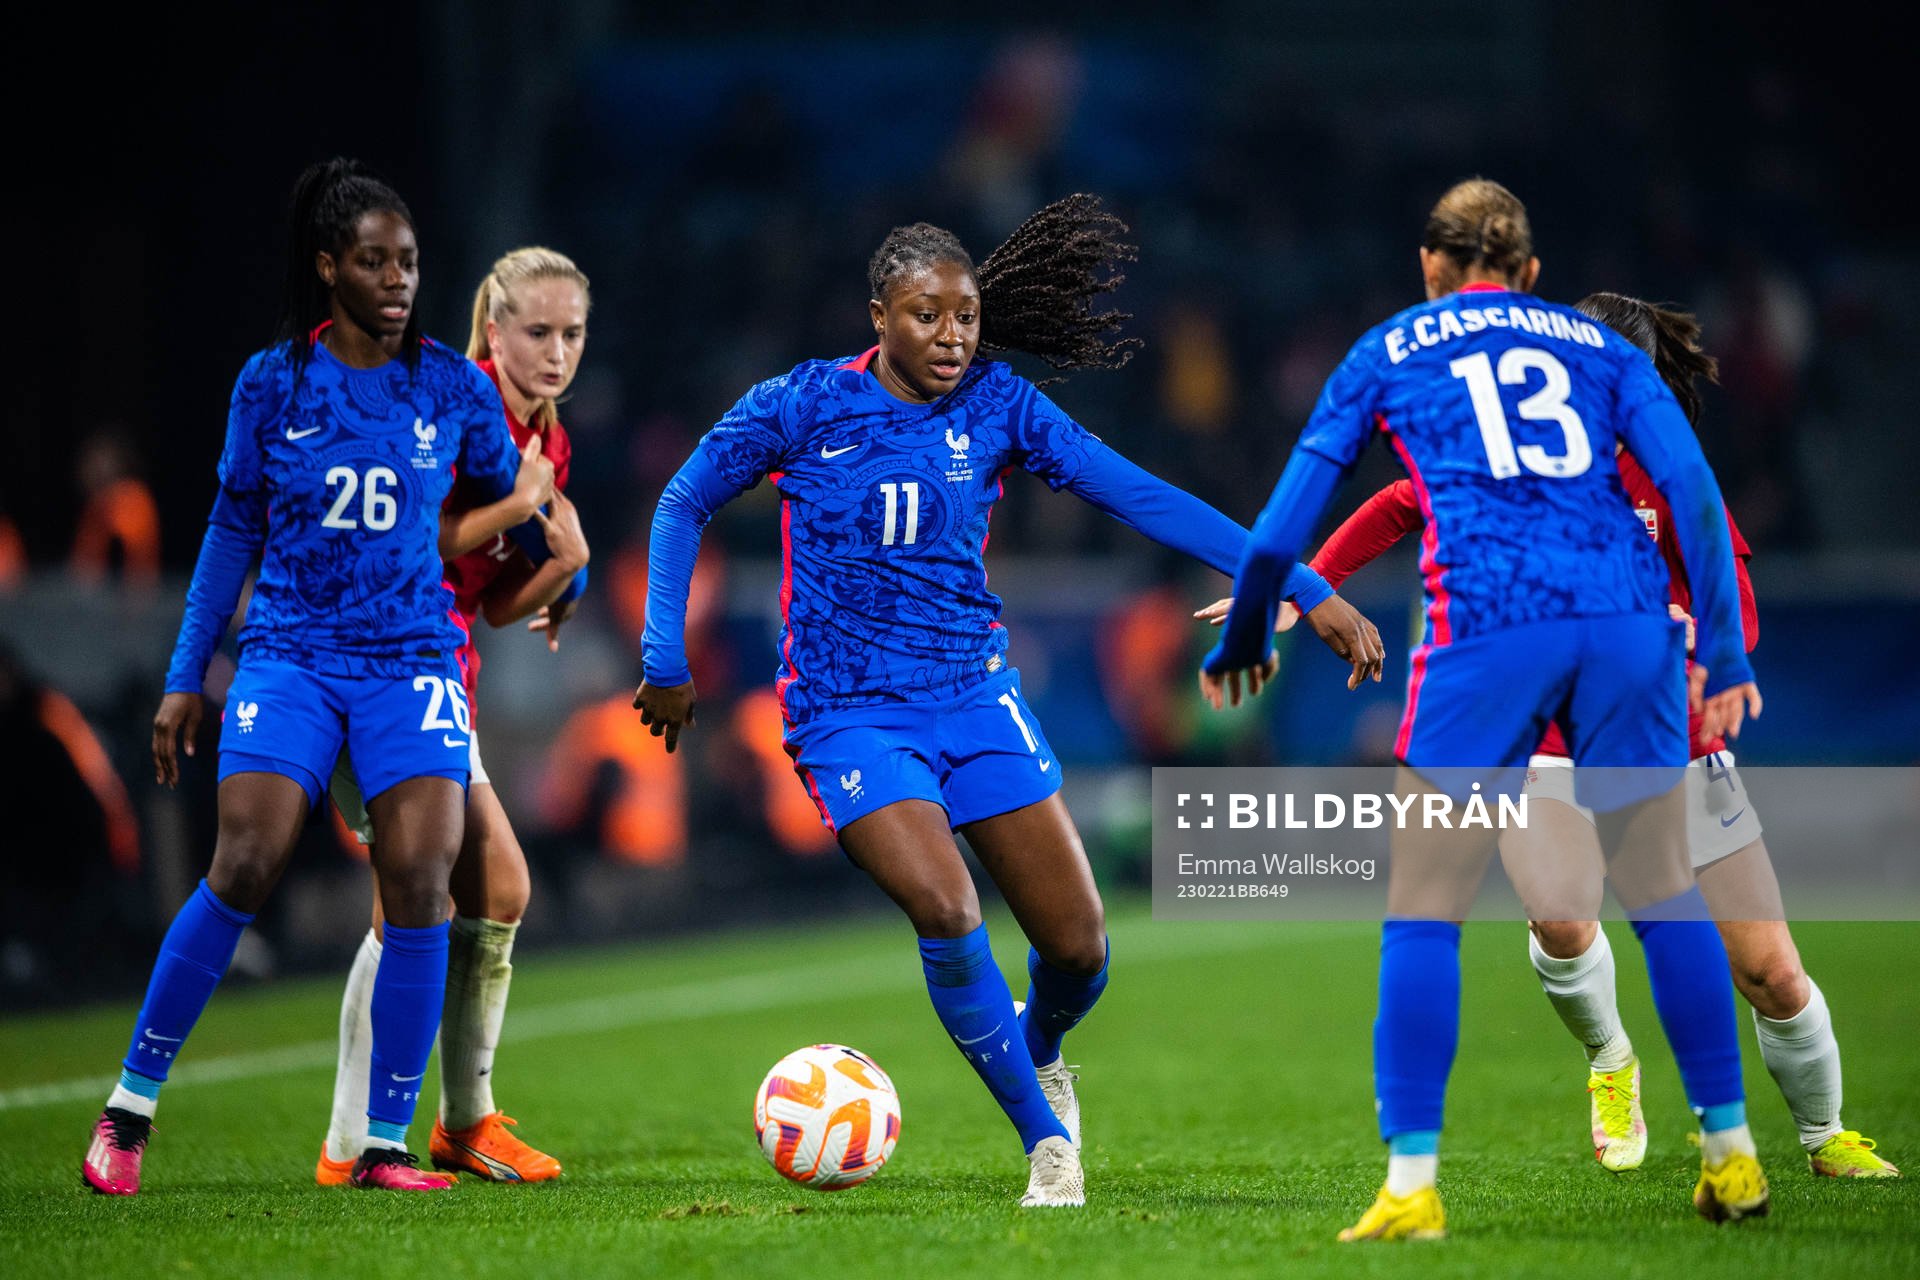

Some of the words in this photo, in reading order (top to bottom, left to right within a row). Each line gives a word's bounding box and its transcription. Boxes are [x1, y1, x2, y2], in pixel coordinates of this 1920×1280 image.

[1384, 306, 1605, 365] E.CASCARINO
[1449, 346, 1593, 480] 13
[321, 466, 398, 531] 26
[879, 482, 919, 546] 11
[413, 675, 470, 735] 26
[1706, 752, 1736, 792] 4
